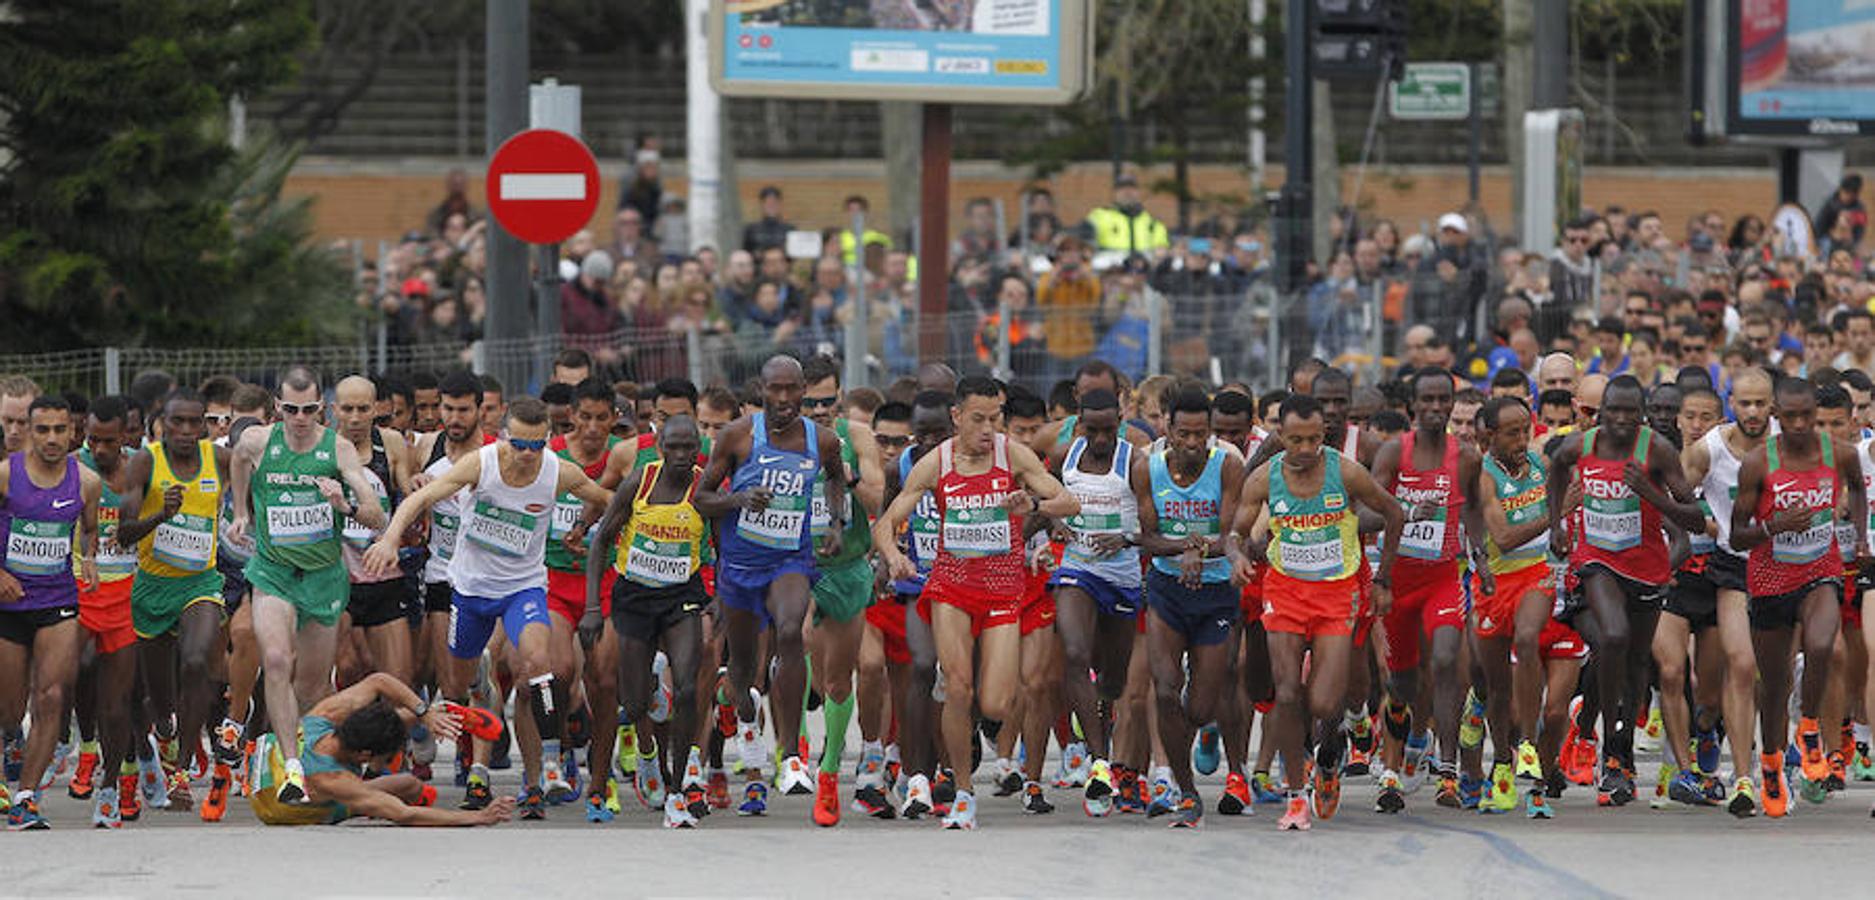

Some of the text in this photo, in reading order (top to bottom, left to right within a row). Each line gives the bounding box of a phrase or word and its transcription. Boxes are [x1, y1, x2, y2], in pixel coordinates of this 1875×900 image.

[760, 468, 804, 496] USA
[945, 488, 1008, 510] BAHRAIN
[1164, 499, 1217, 520] ERITREA
[271, 505, 330, 528] POLLOCK
[746, 510, 800, 530] LAGAT
